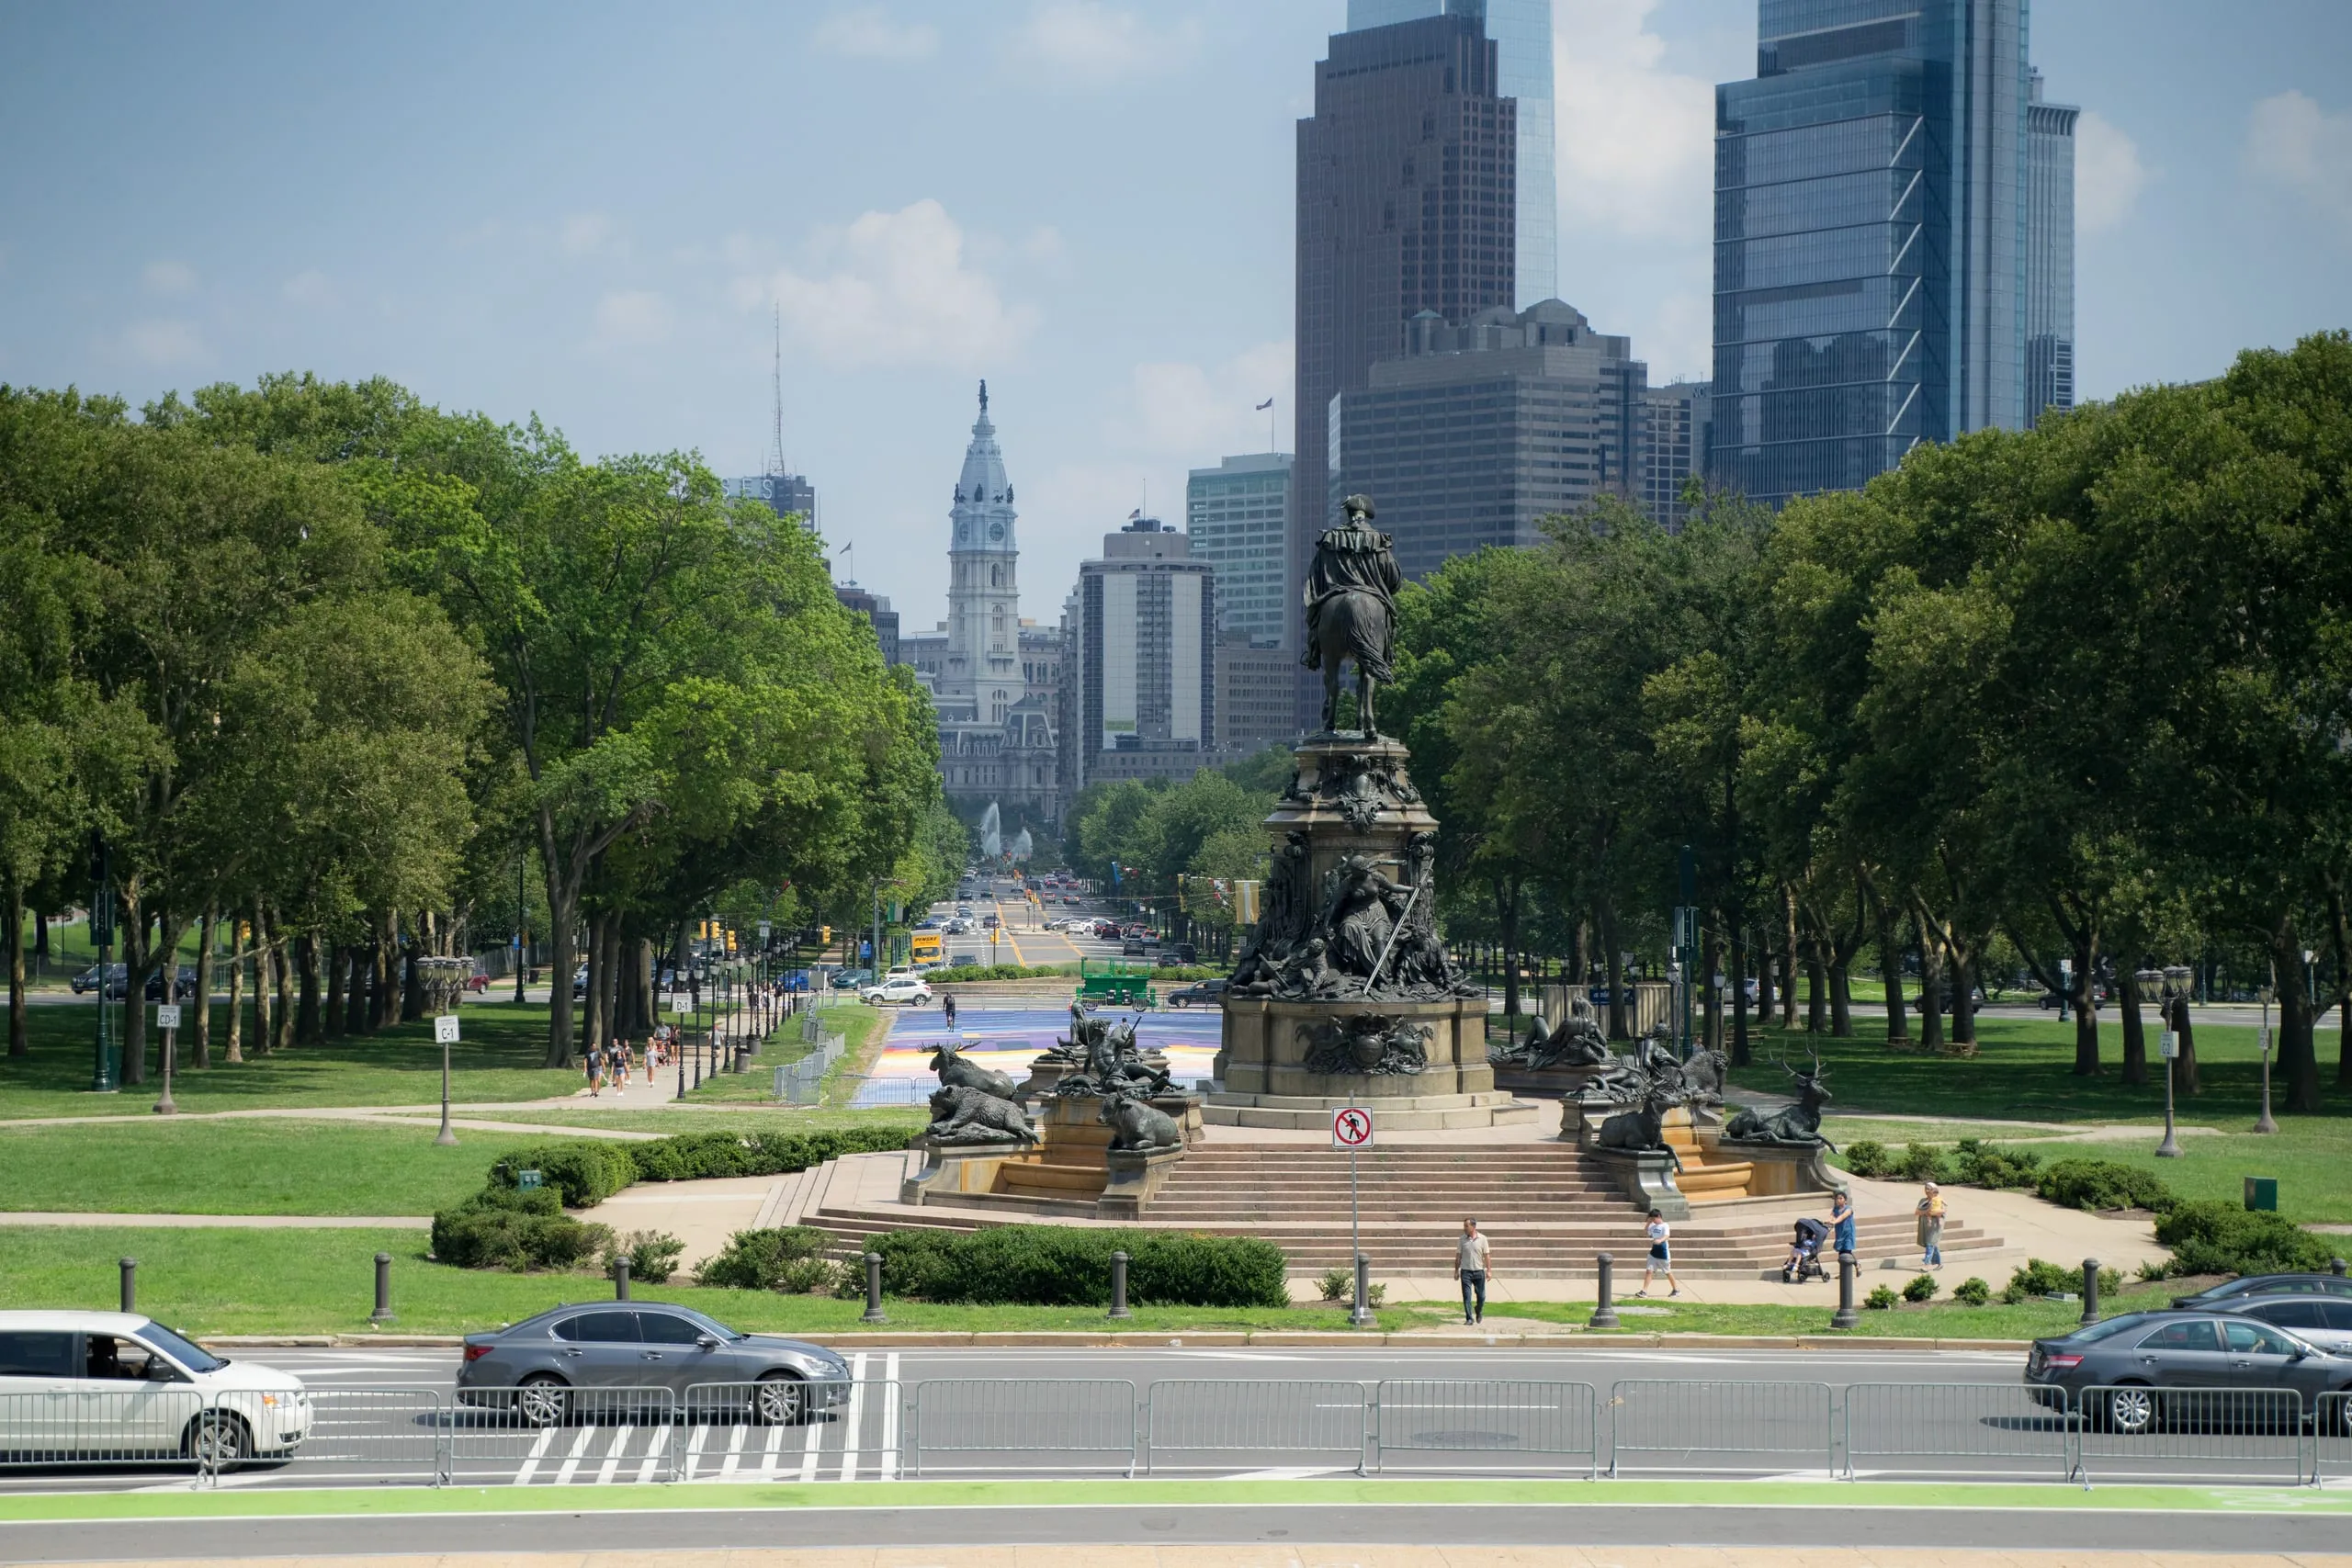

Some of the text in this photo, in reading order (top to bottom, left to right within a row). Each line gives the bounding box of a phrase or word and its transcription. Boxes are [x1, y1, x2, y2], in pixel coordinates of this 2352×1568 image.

[677, 1001, 688, 1010] D-1
[160, 1014, 176, 1025] CD-1
[441, 1028, 454, 1040] C-1
